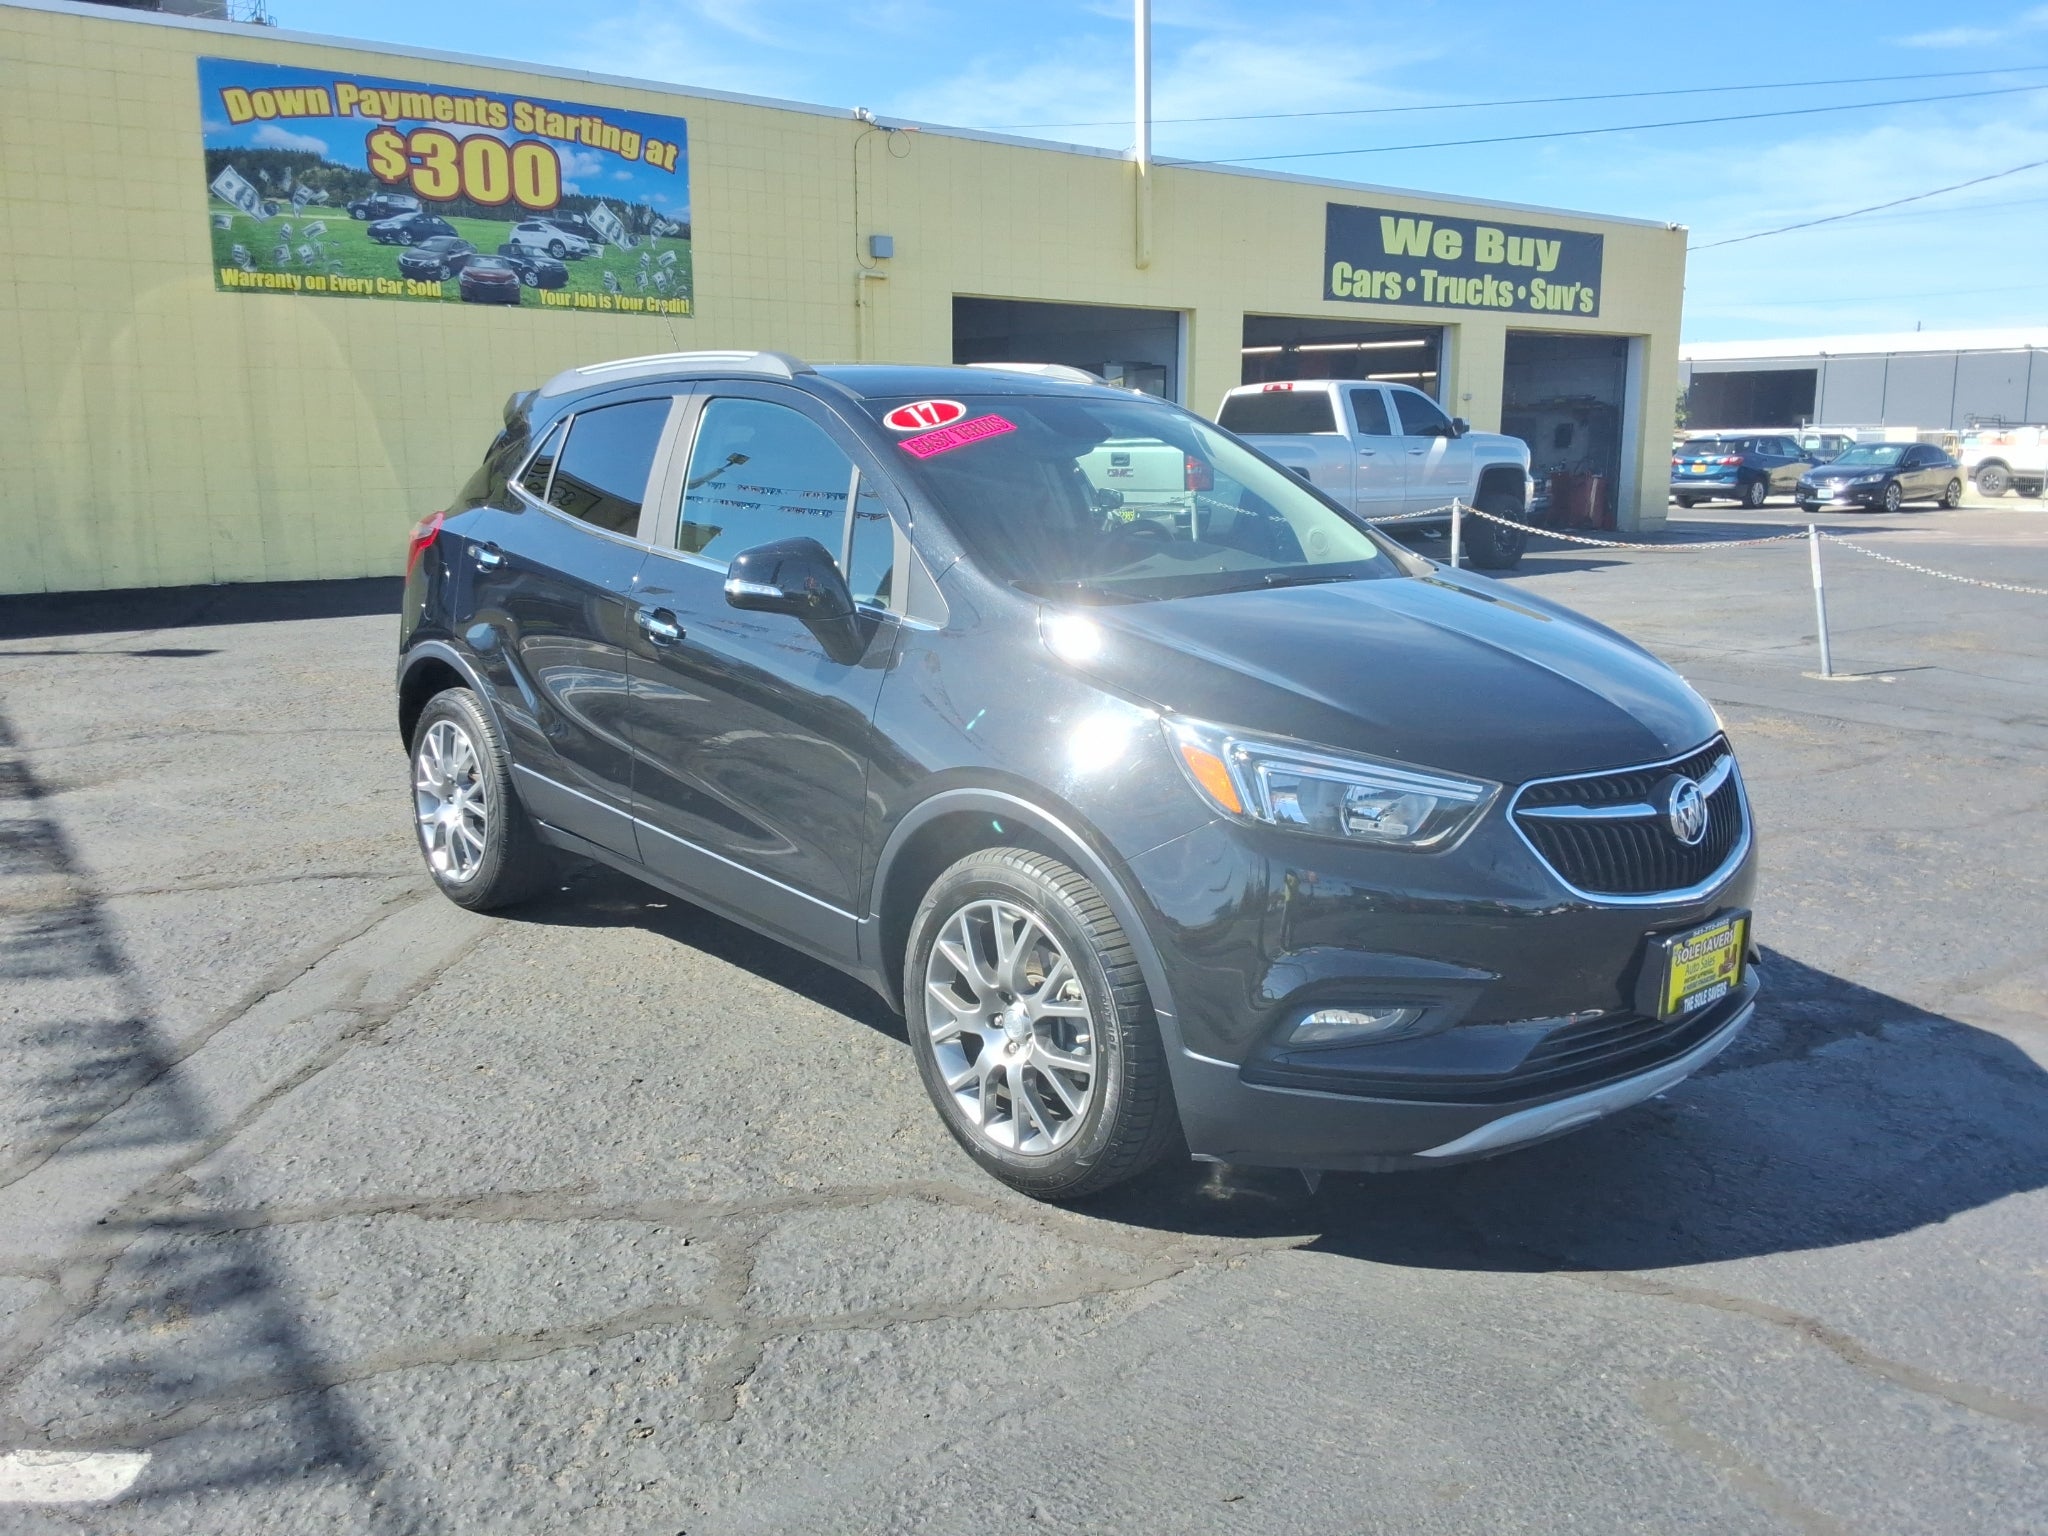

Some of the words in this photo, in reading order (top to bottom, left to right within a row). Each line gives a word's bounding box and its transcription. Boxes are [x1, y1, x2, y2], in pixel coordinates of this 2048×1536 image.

[220, 87, 333, 124] Down
[334, 81, 509, 130] Payments
[513, 101, 642, 161] Starting
[644, 138, 678, 174] at
[366, 125, 561, 210] $300
[1380, 216, 1462, 260] We
[1475, 226, 1561, 272] Buy
[220, 268, 301, 291] Warranty
[304, 275, 326, 290] on
[329, 274, 374, 295] Every
[376, 277, 404, 295] Car
[407, 280, 442, 297] Sold
[1332, 261, 1402, 300] Cars
[1420, 269, 1514, 308] Trucks
[1530, 277, 1594, 313] Suv's
[539, 289, 571, 305] Your
[573, 291, 597, 308] Job
[599, 293, 612, 308] is
[613, 294, 644, 311] Your
[646, 297, 690, 314] Credit!
[904, 402, 941, 428] 17
[908, 430, 957, 454] EASY
[951, 415, 1009, 440] TERMS
[1702, 930, 1734, 955] SAVERS
[1684, 997, 1694, 1013] THE
